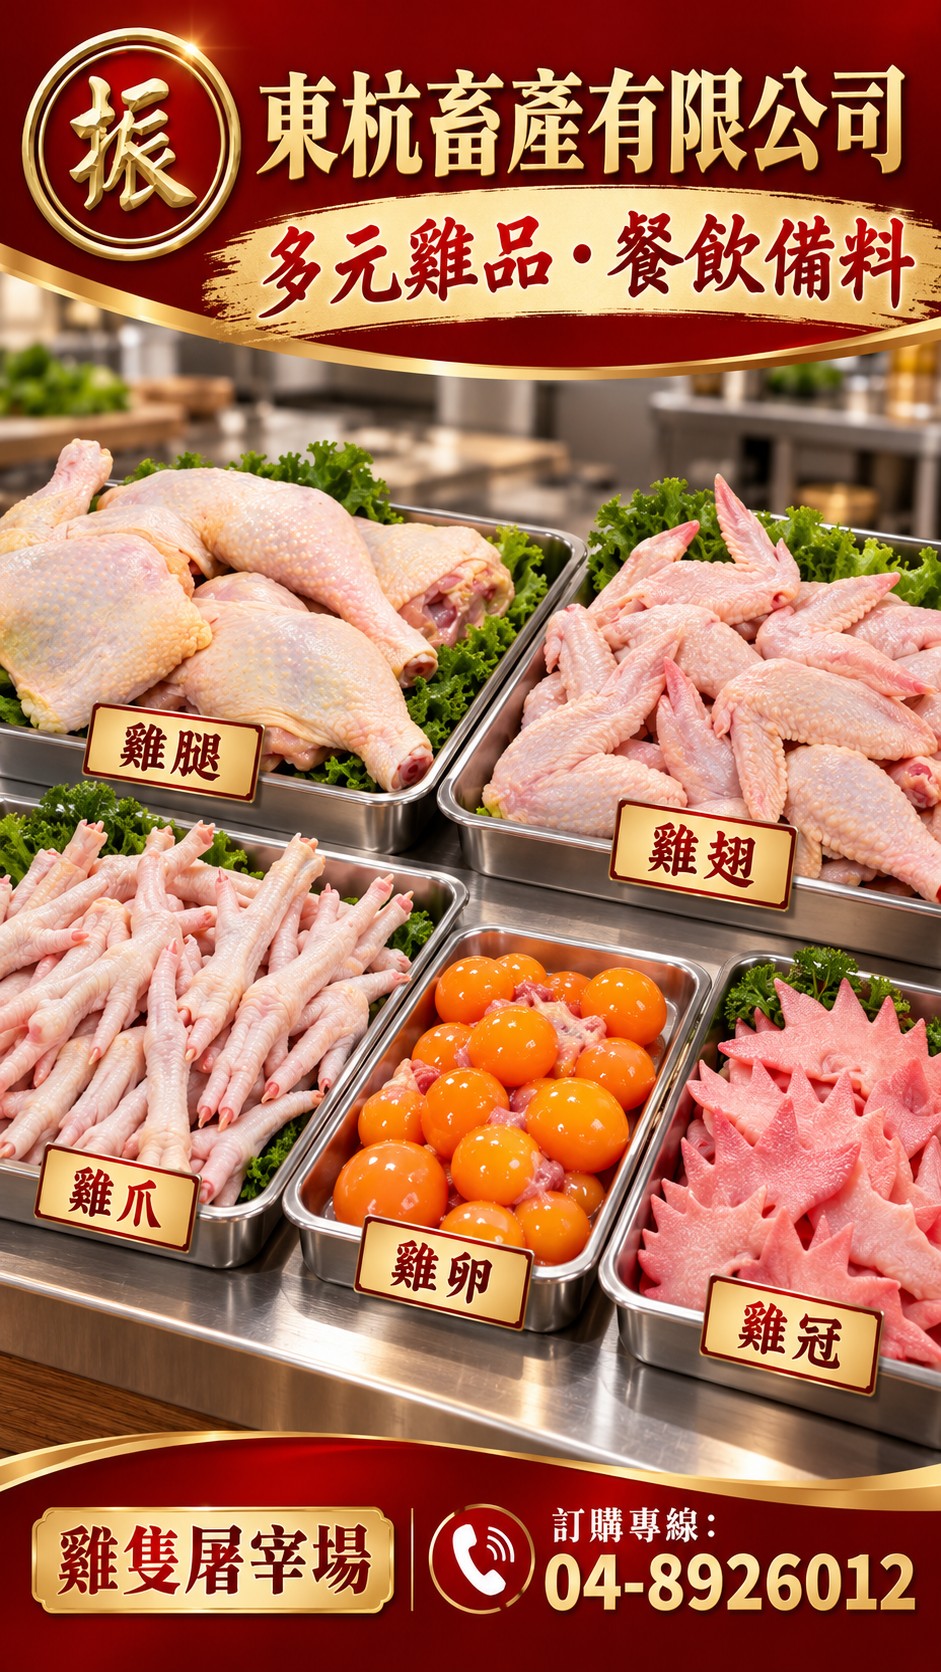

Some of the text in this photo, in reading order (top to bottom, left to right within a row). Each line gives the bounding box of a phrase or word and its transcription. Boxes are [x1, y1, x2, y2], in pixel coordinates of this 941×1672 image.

[119, 722, 221, 781] 雞腿
[648, 823, 755, 888] 雞翅
[69, 1167, 160, 1229] 雞爪
[391, 1240, 492, 1304] 雞卵
[738, 1302, 841, 1369] 雞冠
